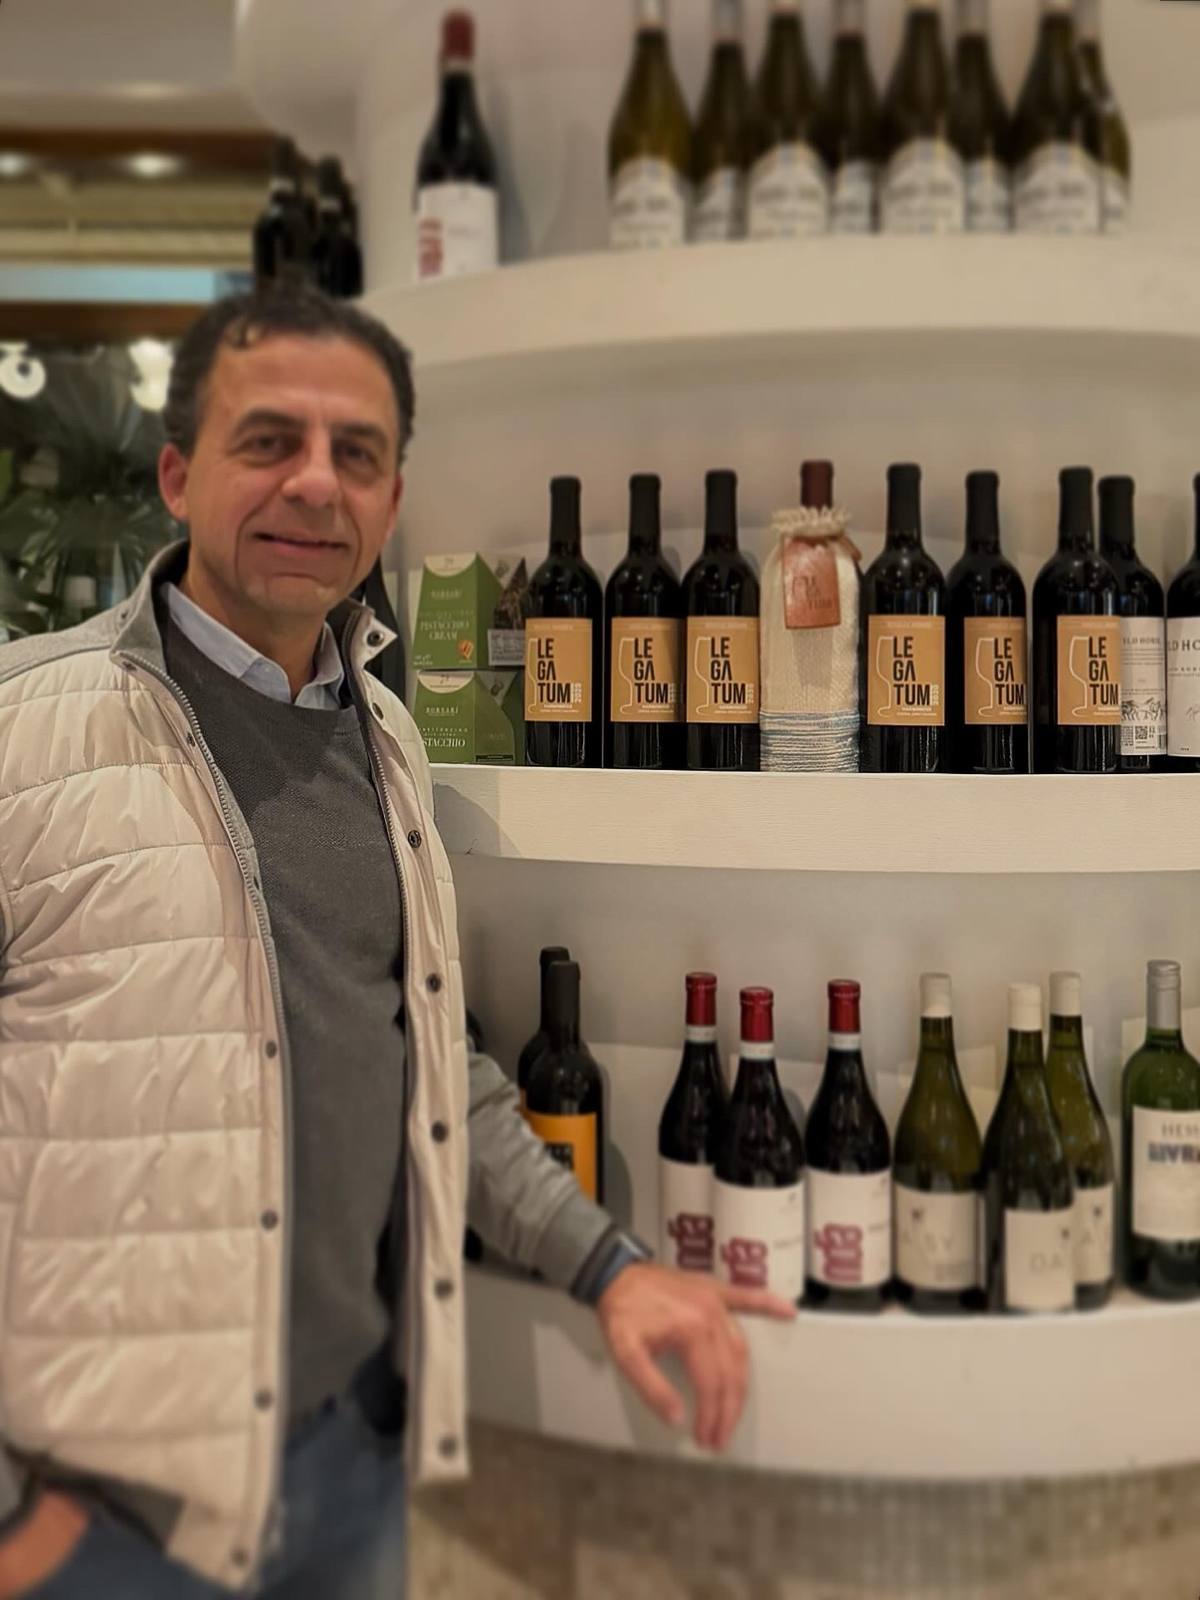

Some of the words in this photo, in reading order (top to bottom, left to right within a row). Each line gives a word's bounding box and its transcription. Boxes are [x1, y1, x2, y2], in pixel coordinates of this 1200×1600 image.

[537, 638, 554, 659] LE
[634, 638, 653, 658] LE
[711, 637, 730, 658] LE
[893, 636, 914, 658] LE
[994, 638, 1012, 659] LE
[1088, 636, 1107, 658] LE
[537, 660, 556, 681] GA
[634, 660, 655, 681] GA
[711, 660, 732, 681] GA
[893, 660, 916, 682] GA
[994, 661, 1015, 682] GA
[1088, 660, 1109, 682] GA
[537, 683, 571, 704] TUM
[634, 682, 668, 704] TUM
[711, 683, 746, 704] TUM
[893, 684, 930, 706] TUM
[995, 684, 1025, 705] TUM
[1089, 683, 1119, 705] TUM
